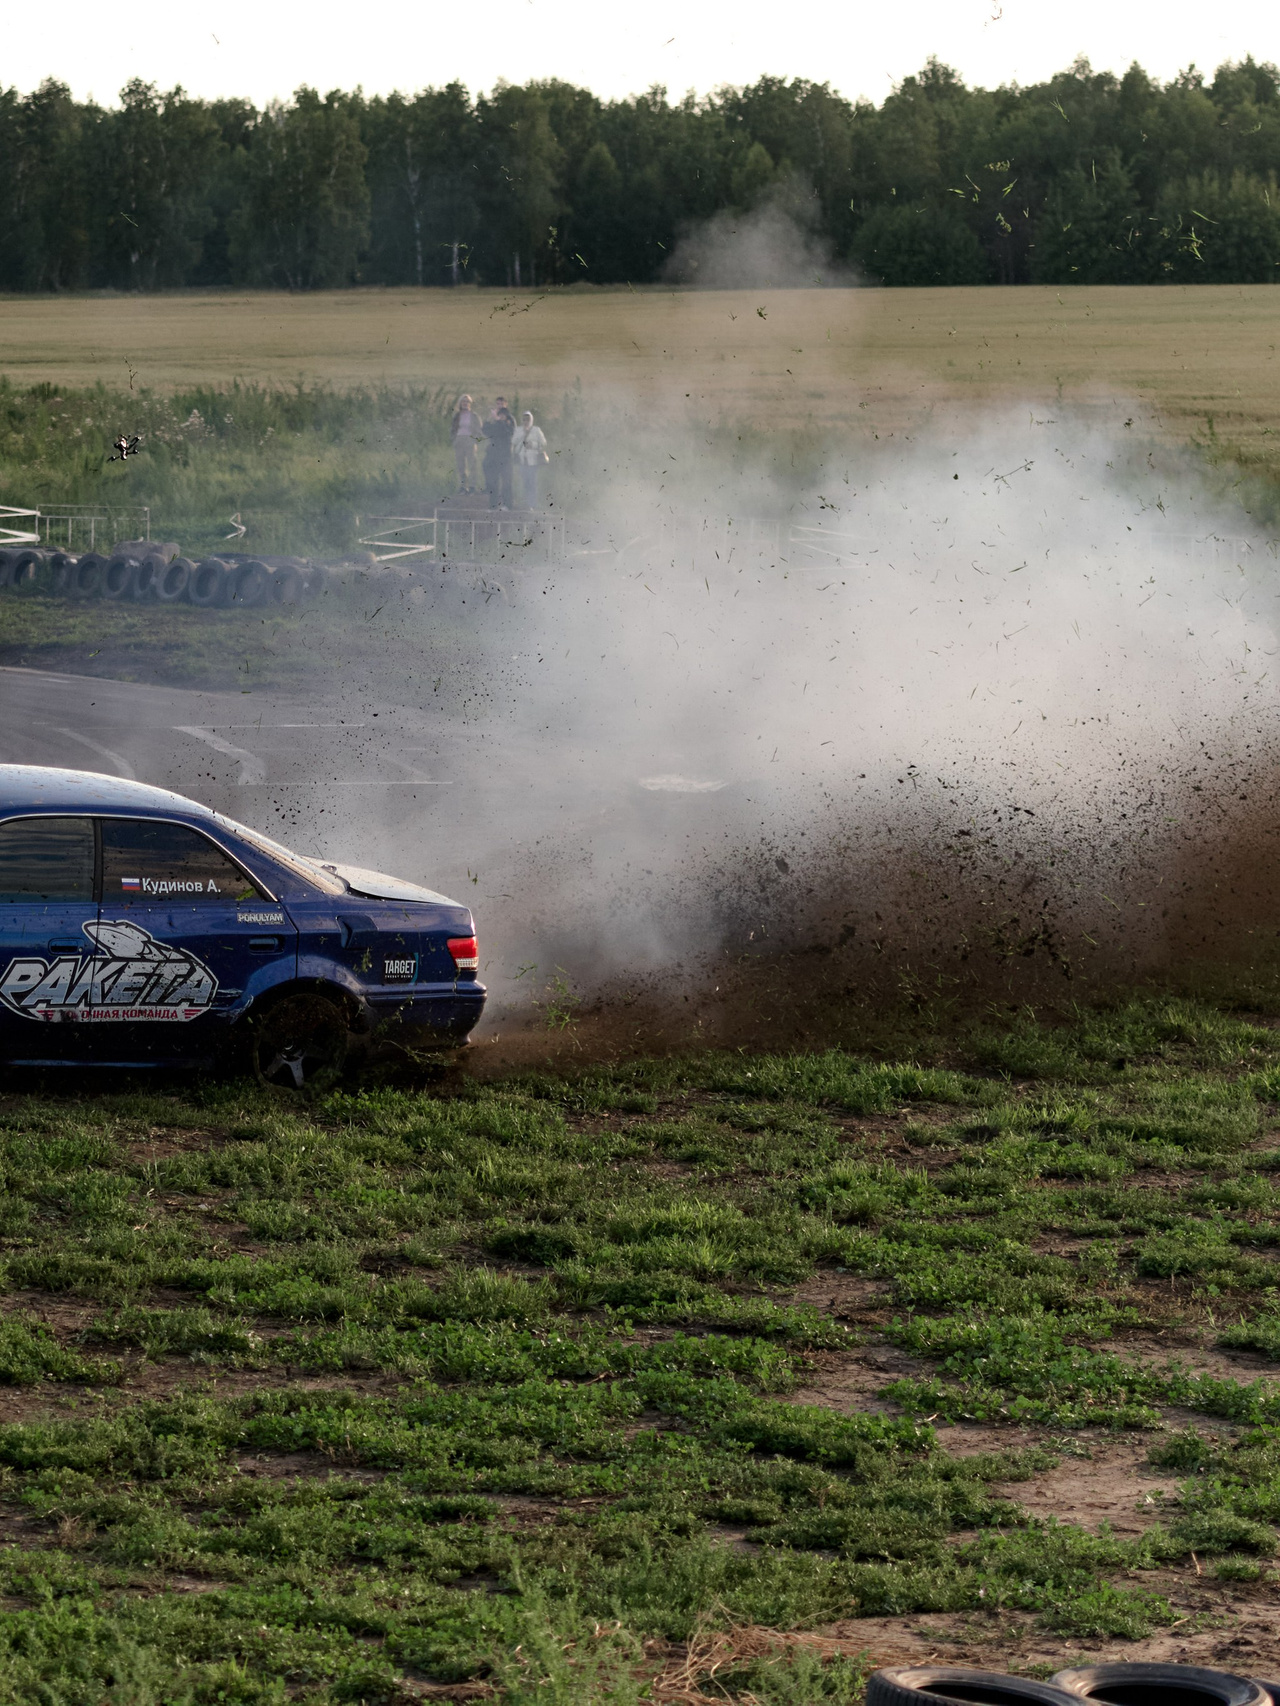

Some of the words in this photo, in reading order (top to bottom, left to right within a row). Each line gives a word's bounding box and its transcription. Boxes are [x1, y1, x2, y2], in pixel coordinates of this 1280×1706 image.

[142, 878, 204, 894] Кудинов
[207, 879, 222, 893] А.
[384, 960, 416, 974] TARGET
[122, 1009, 178, 1019] КОМАНДА
